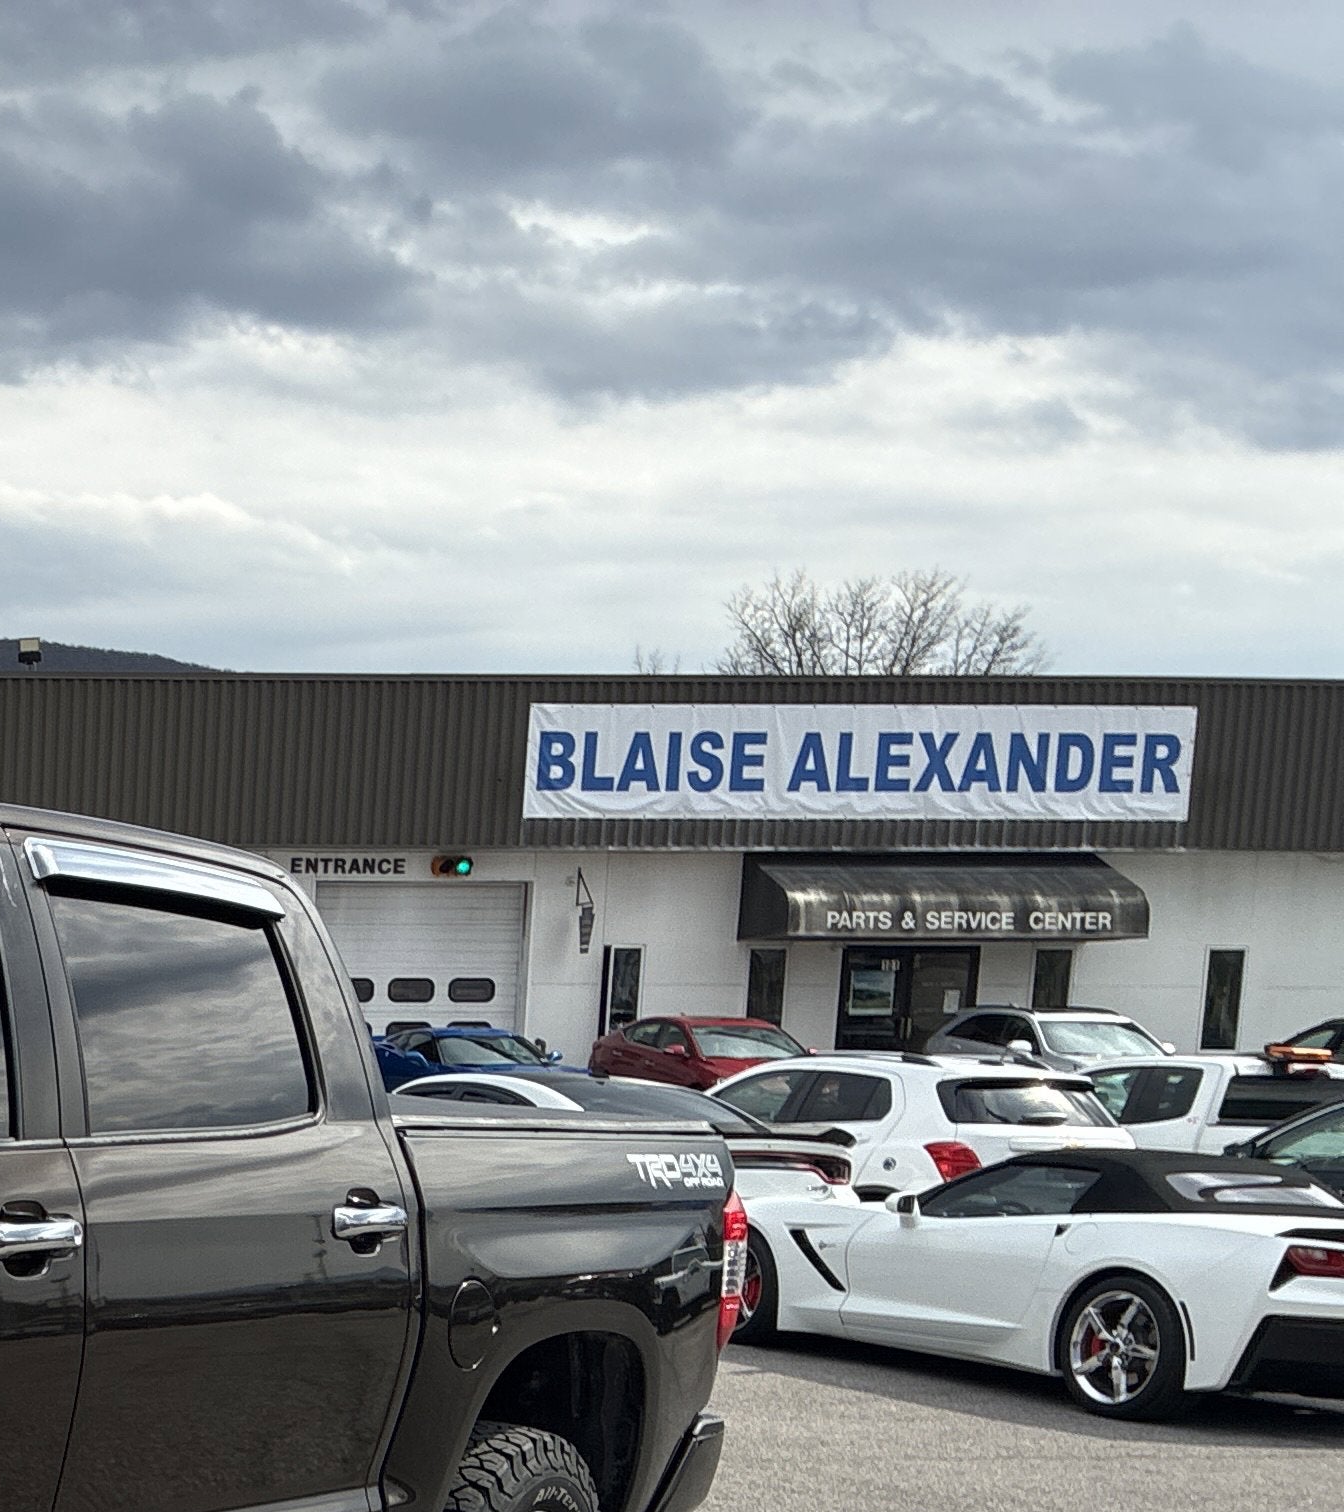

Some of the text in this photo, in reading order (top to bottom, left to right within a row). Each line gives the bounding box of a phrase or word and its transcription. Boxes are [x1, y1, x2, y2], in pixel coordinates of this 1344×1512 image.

[536, 731, 1181, 793] BLAISE ALEXANDER
[290, 858, 406, 874] ENTRANCE
[826, 911, 1112, 930] PARTS & SERVICE CENTER
[700, 1177, 725, 1188] ROAD
